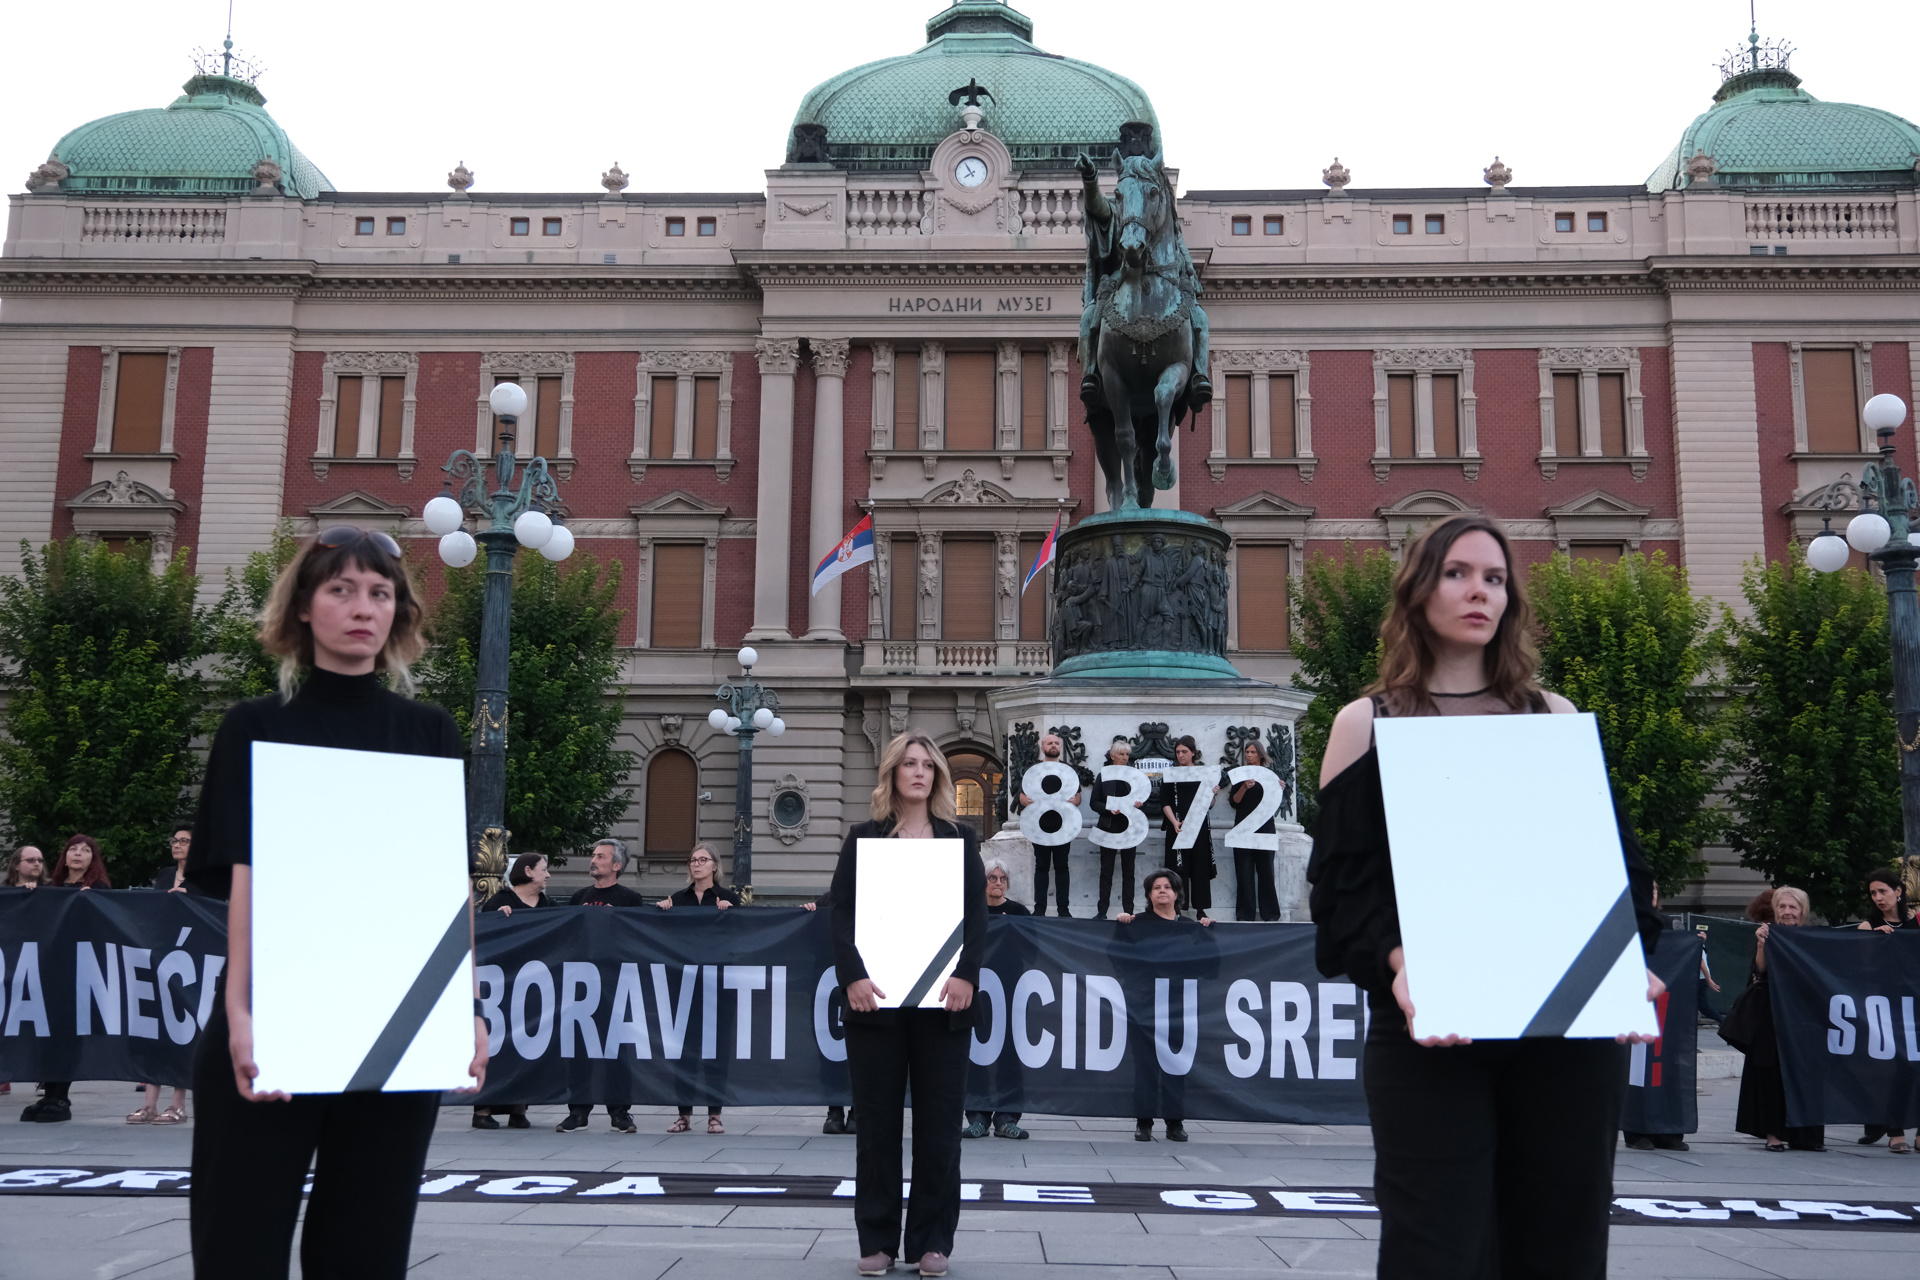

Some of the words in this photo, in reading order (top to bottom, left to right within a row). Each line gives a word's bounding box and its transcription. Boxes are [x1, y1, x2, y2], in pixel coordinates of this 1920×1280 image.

[889, 297, 982, 312] НАРОДНИ
[997, 296, 1053, 312] МУЗЕЈ
[1020, 762, 1283, 852] 8372
[0, 941, 51, 1038] A
[814, 966, 1128, 1072] GOCID
[1154, 979, 1199, 1076] U
